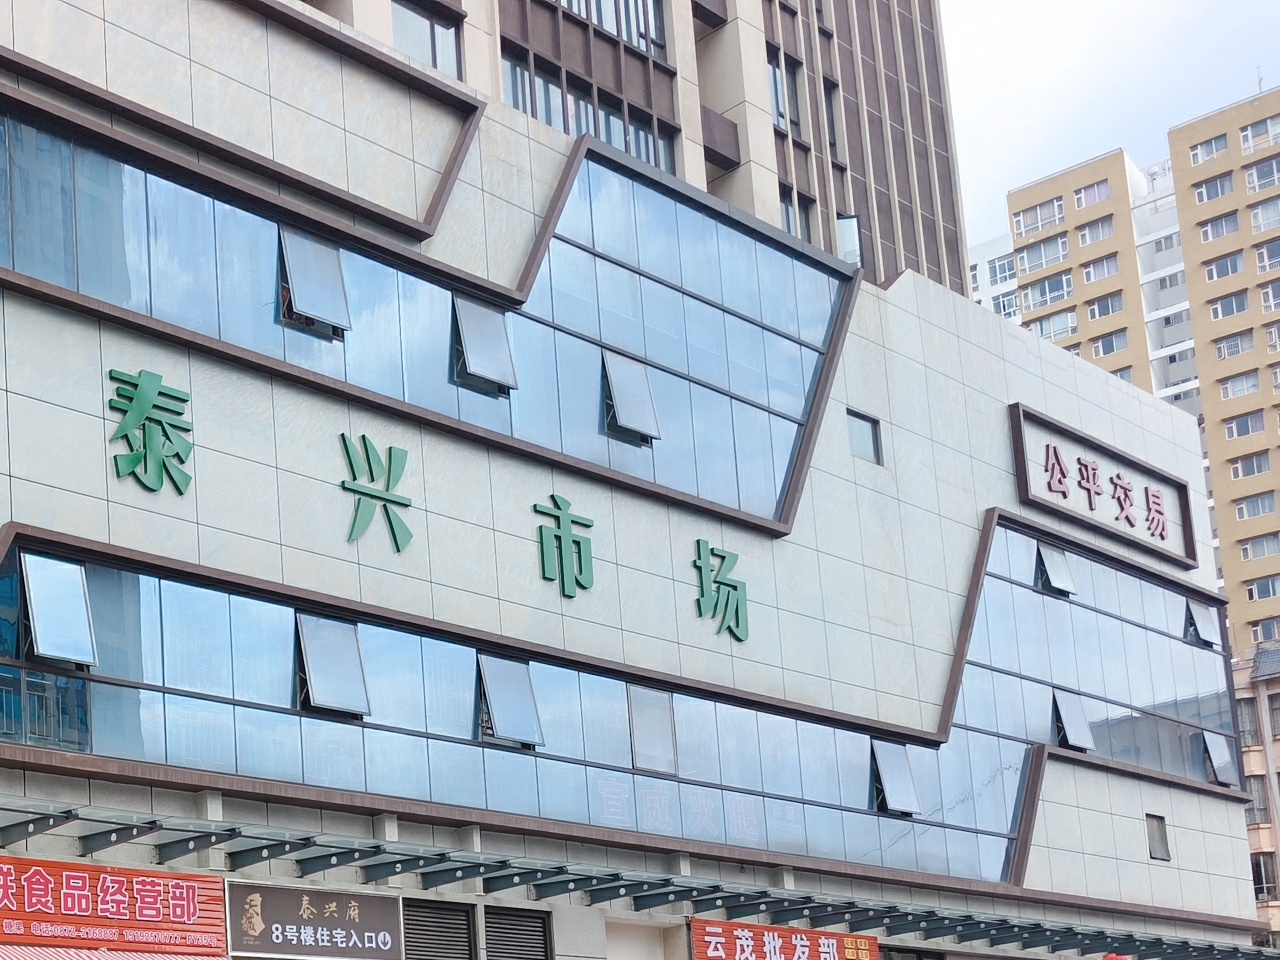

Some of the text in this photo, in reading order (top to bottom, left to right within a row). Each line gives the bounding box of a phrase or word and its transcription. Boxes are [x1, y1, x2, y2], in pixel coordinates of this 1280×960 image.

[108, 368, 749, 642] 泰兴市场
[1045, 443, 1169, 541] 公平交易
[598, 777, 759, 841] 宣威火腿
[298, 894, 361, 924] 泰兴府
[186, 933, 218, 947] PY35号
[271, 923, 377, 949] 8号楼住宅入口
